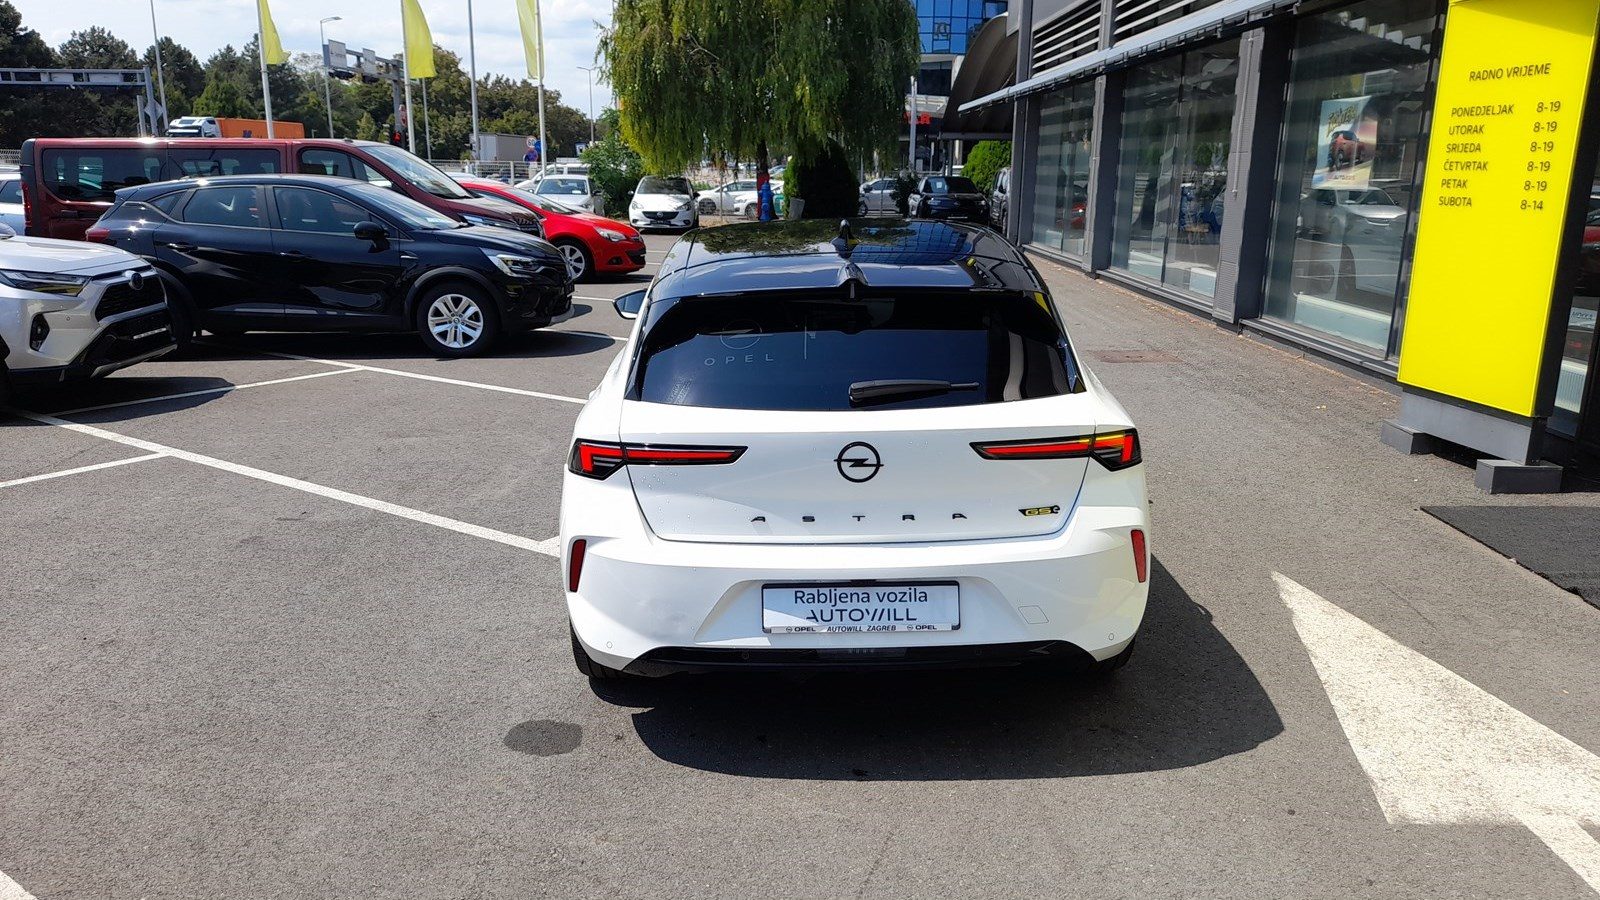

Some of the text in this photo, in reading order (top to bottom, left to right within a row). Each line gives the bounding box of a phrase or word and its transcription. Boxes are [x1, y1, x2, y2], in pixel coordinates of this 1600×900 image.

[1469, 63, 1551, 81] RADNO VRIJEME
[1451, 101, 1561, 117] PONEDJELJAK 8-19
[1448, 121, 1557, 135] UTORAK 8-19
[1446, 141, 1554, 153] SRIJEDA 8-19
[1527, 161, 1550, 172] 8-19
[1441, 179, 1547, 192] PETAK 8-19
[1439, 196, 1543, 210] SUBOTA 8-14
[704, 353, 774, 366] OPEL
[751, 513, 967, 522] ASTRA
[794, 587, 928, 607] Rabljena vozila
[805, 608, 917, 622] AUTOWILL
[826, 625, 863, 633] AUTOWILL
[867, 624, 897, 632] ZAGREB
